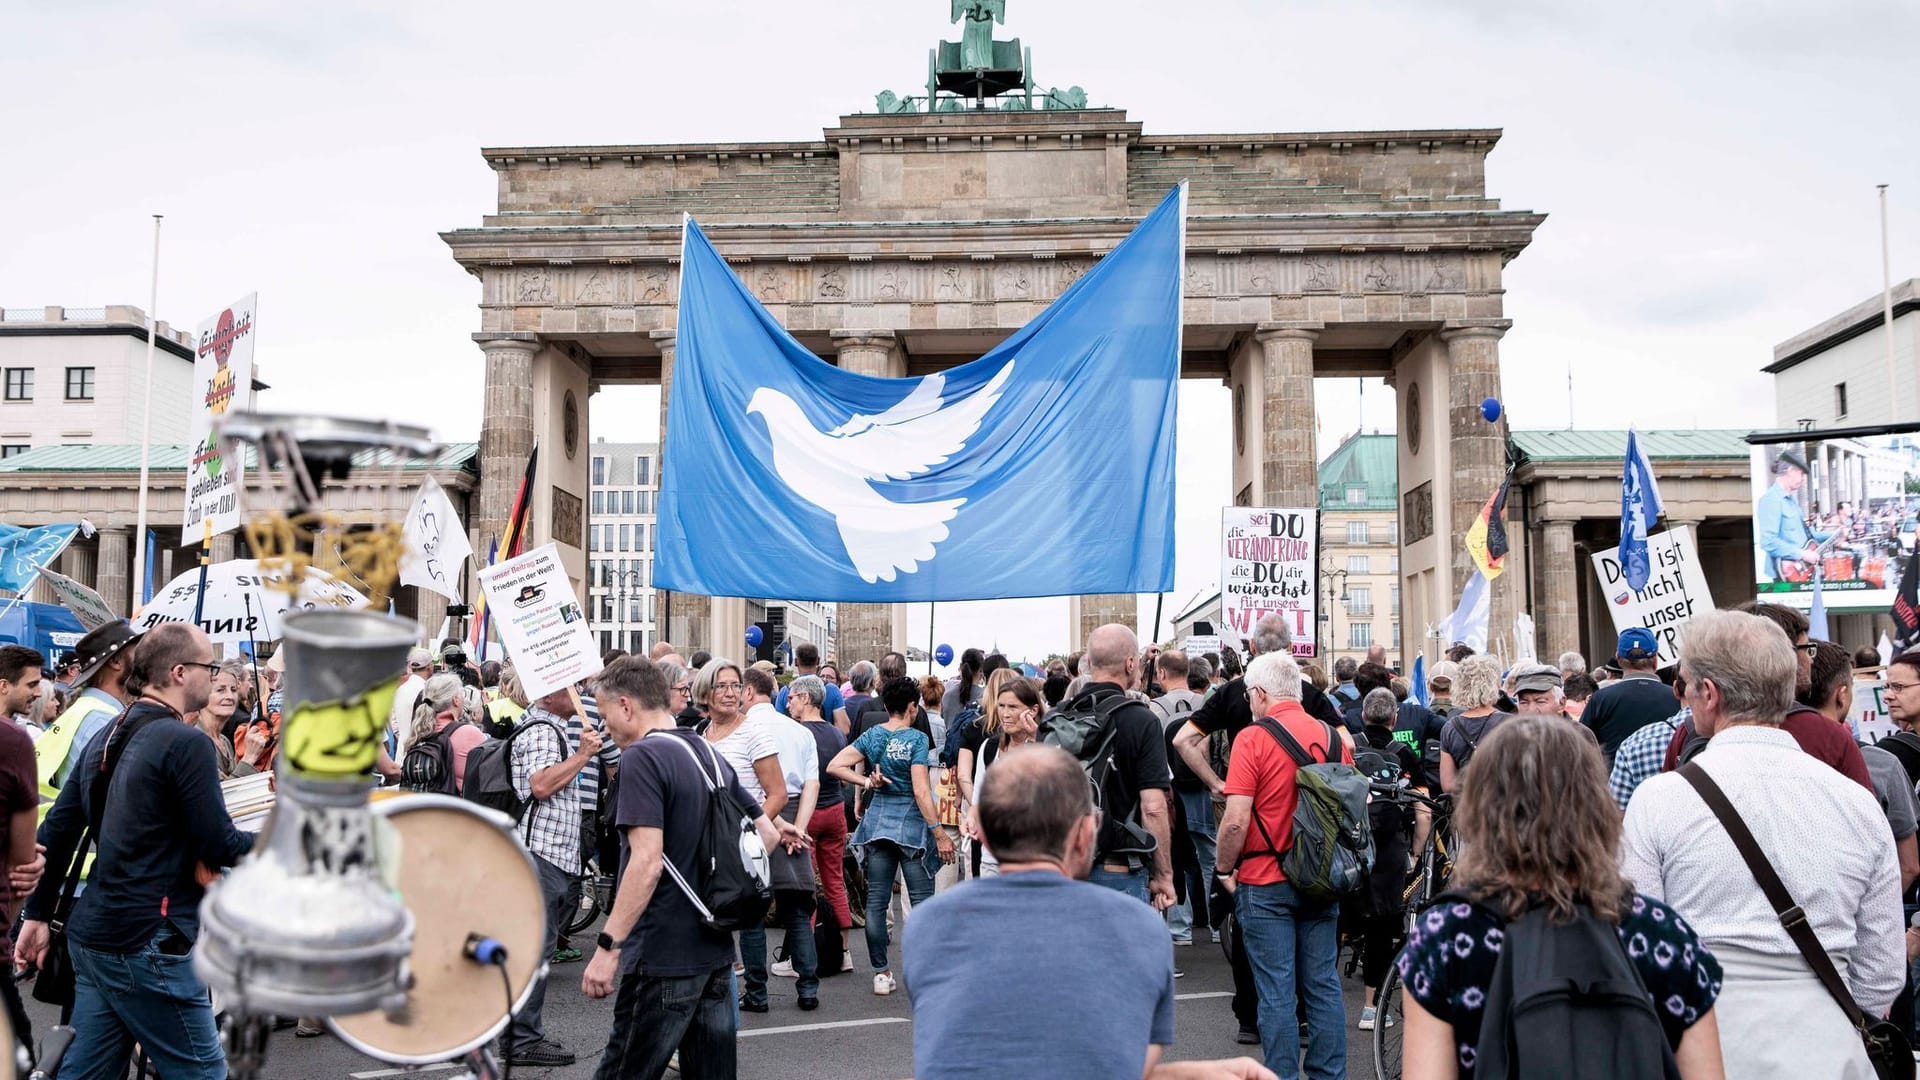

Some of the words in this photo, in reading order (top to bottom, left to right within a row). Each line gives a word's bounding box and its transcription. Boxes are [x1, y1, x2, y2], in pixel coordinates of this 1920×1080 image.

[206, 371, 236, 408] Recht
[191, 472, 222, 504] geblieben
[1227, 527, 1245, 538] die
[1250, 512, 1269, 525] sei
[1268, 512, 1304, 539] DU
[1227, 534, 1308, 562] VERÄNDERUNG
[1657, 541, 1686, 568] ist
[492, 578, 518, 593] Frieden
[525, 572, 537, 581] der
[538, 563, 556, 576] Welt?
[511, 561, 536, 574] Beitrag
[535, 555, 549, 565] zum
[1231, 565, 1250, 577] die
[1252, 562, 1284, 583] DU
[1285, 567, 1304, 578] dir
[1228, 579, 1311, 598] wünschst
[1634, 569, 1684, 603] nicht
[1240, 595, 1259, 609] für
[1262, 599, 1300, 609] unsere
[1642, 597, 1694, 629] unser
